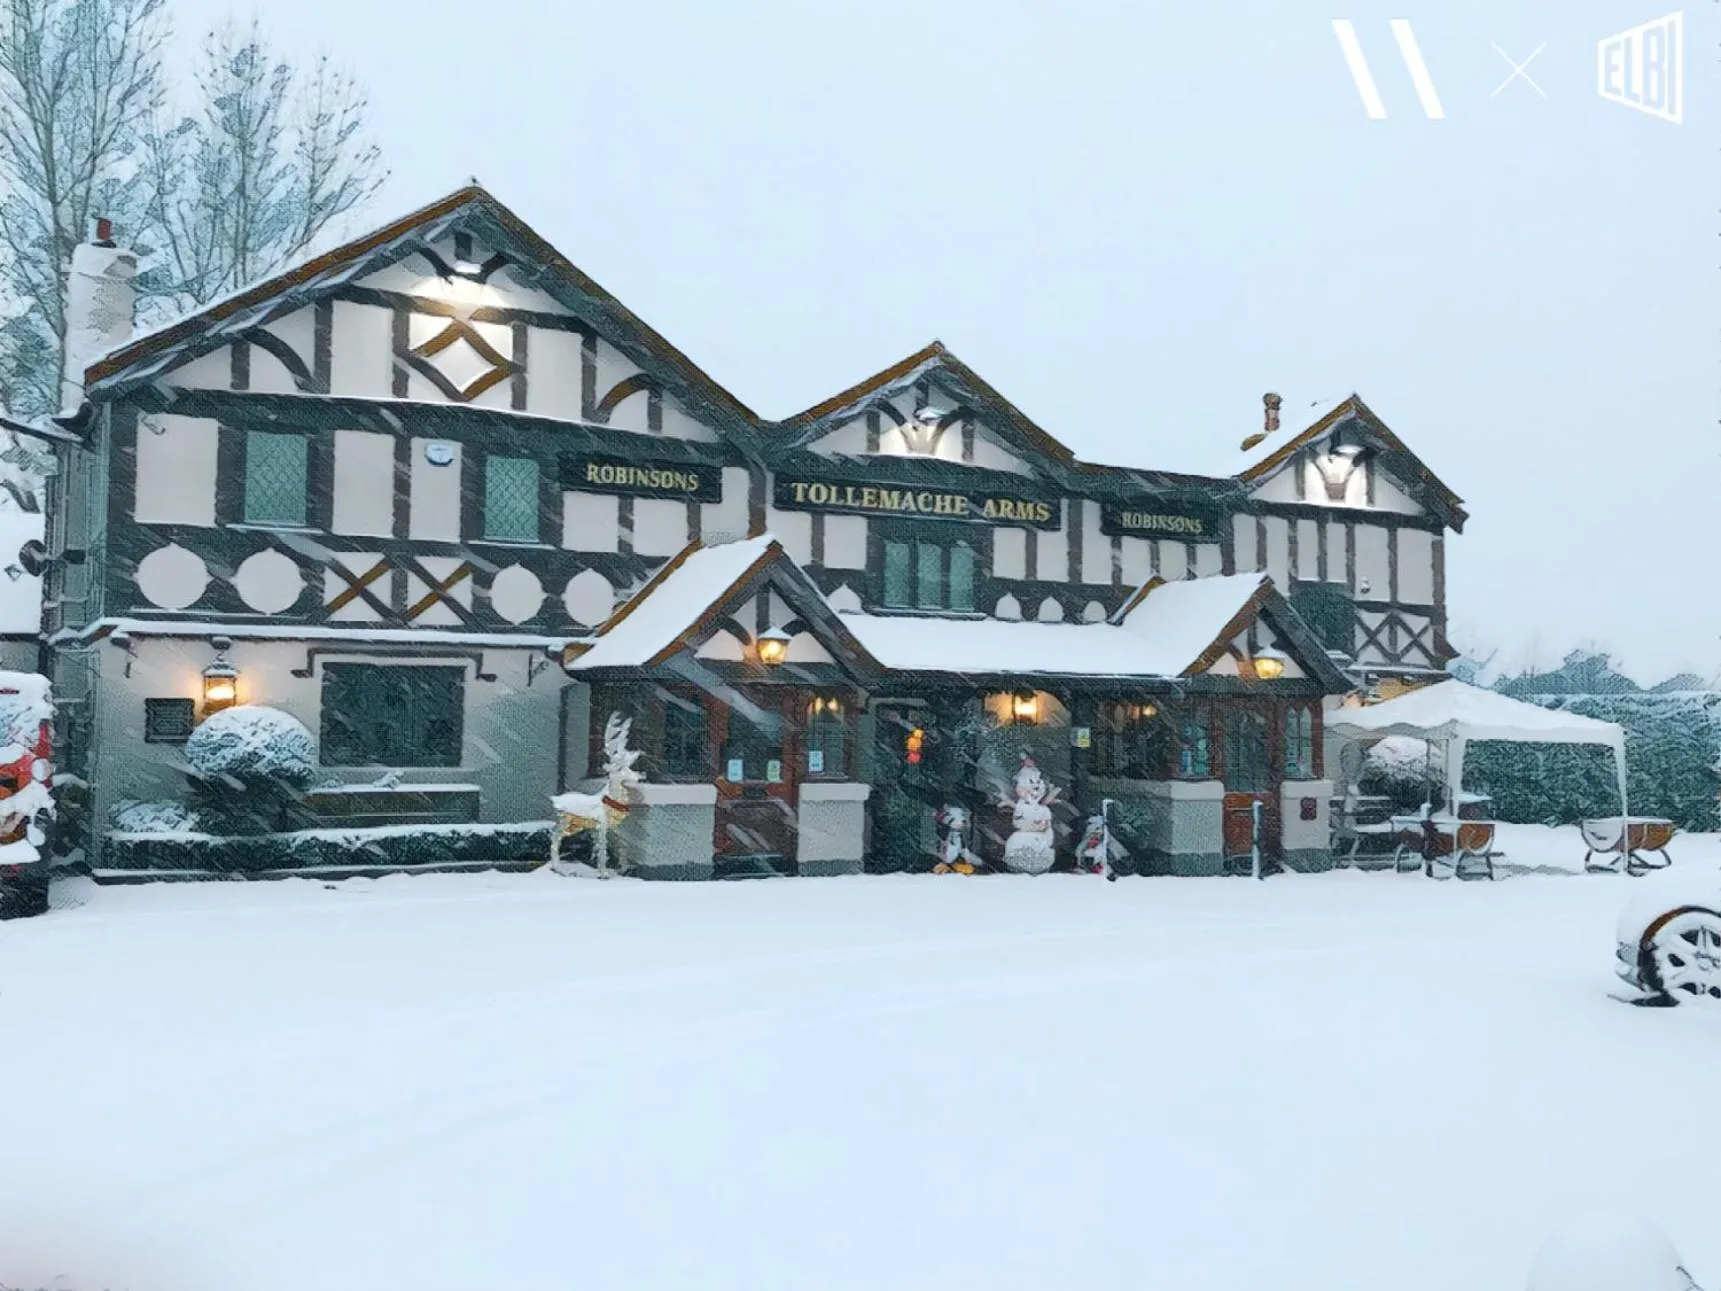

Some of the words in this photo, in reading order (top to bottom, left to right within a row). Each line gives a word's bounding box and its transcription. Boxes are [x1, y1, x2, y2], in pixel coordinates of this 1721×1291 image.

[586, 462, 700, 492] ROBINSONS
[791, 482, 969, 515] TOLLEMACHE
[982, 499, 1050, 522] ARMS
[1121, 511, 1202, 534] ROBINSONS
